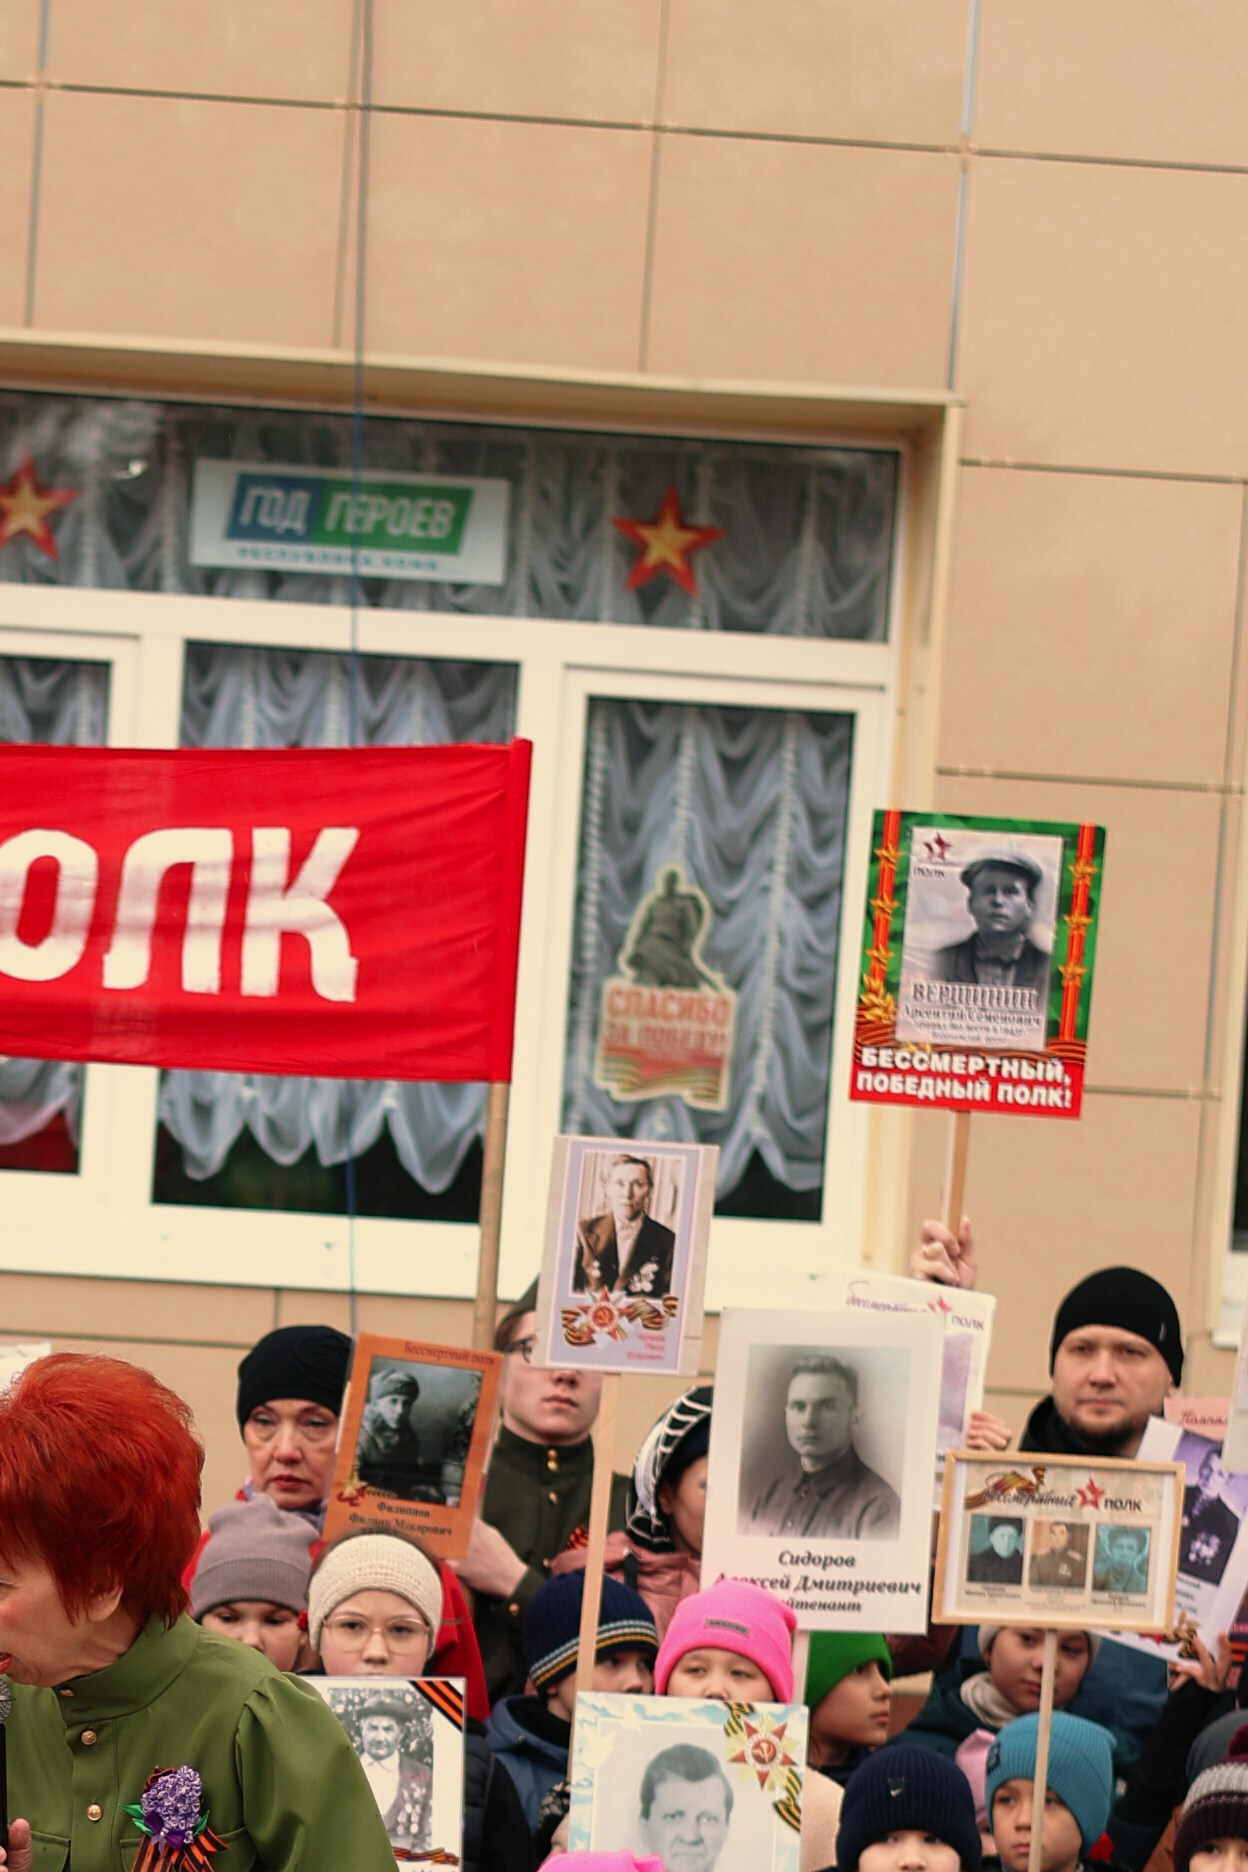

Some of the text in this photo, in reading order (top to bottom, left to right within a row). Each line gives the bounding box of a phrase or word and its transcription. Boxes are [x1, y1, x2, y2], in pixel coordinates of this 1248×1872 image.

[239, 485, 456, 539] ГОД ГЕРОЕВ
[860, 1046, 1072, 1085] БЕССМЕРТНЫЙ,
[857, 1071, 1073, 1109] ПОБЕДНЫЙ ПОЛК!
[778, 1550, 856, 1571] Сидоров
[794, 1575, 922, 1596] Дмитриевич
